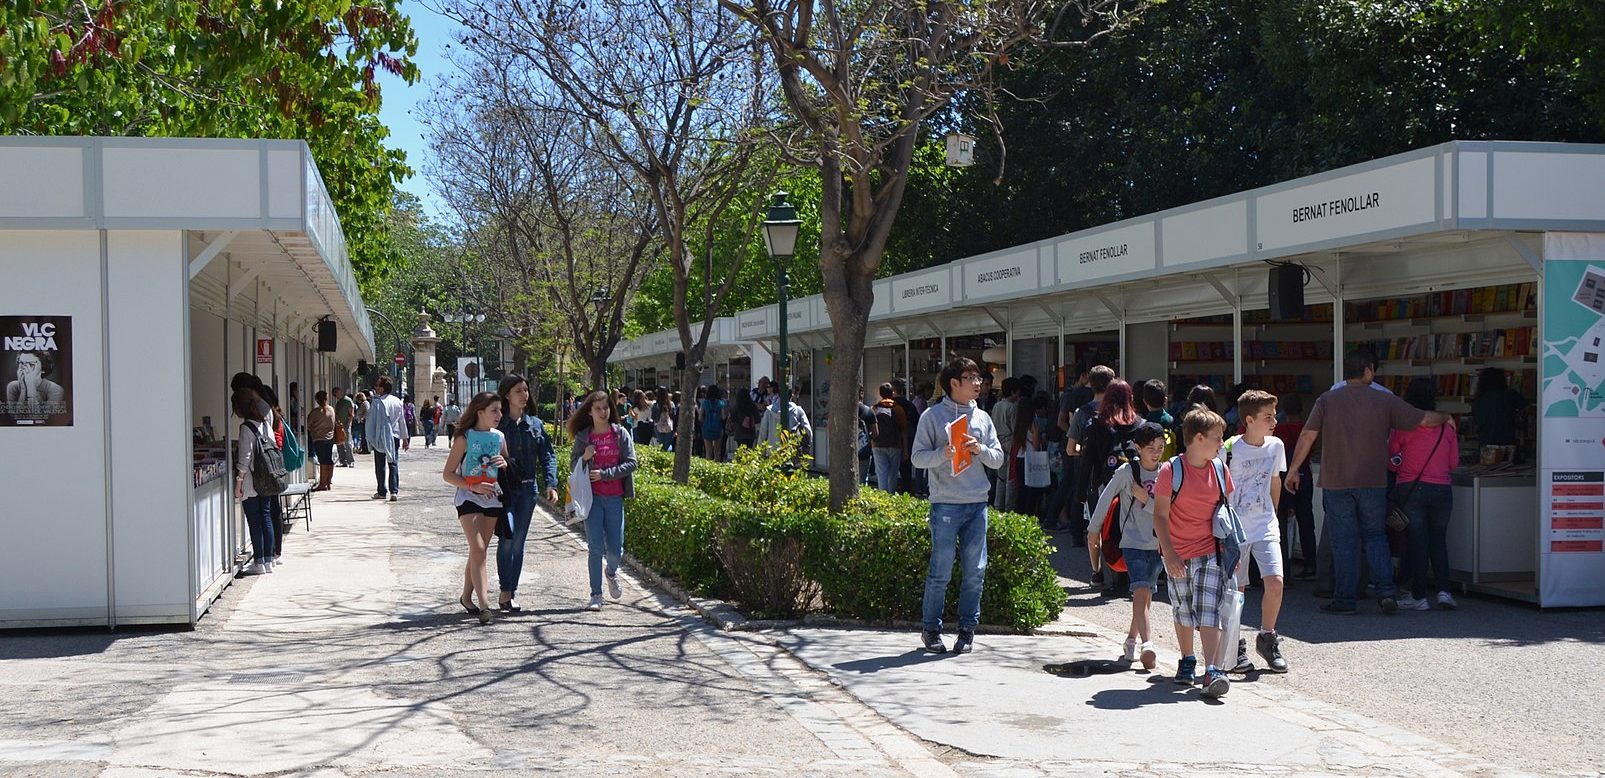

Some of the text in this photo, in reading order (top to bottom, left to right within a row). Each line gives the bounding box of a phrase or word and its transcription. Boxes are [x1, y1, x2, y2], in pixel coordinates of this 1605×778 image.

[1292, 192, 1380, 223] BERNAT FENOLLAR
[1080, 244, 1128, 264] BERNAT FENOLLAR
[977, 266, 1021, 283] ABACUS COOPERATIVA
[22, 323, 56, 336] VLC
[4, 337, 58, 351] NEGRA
